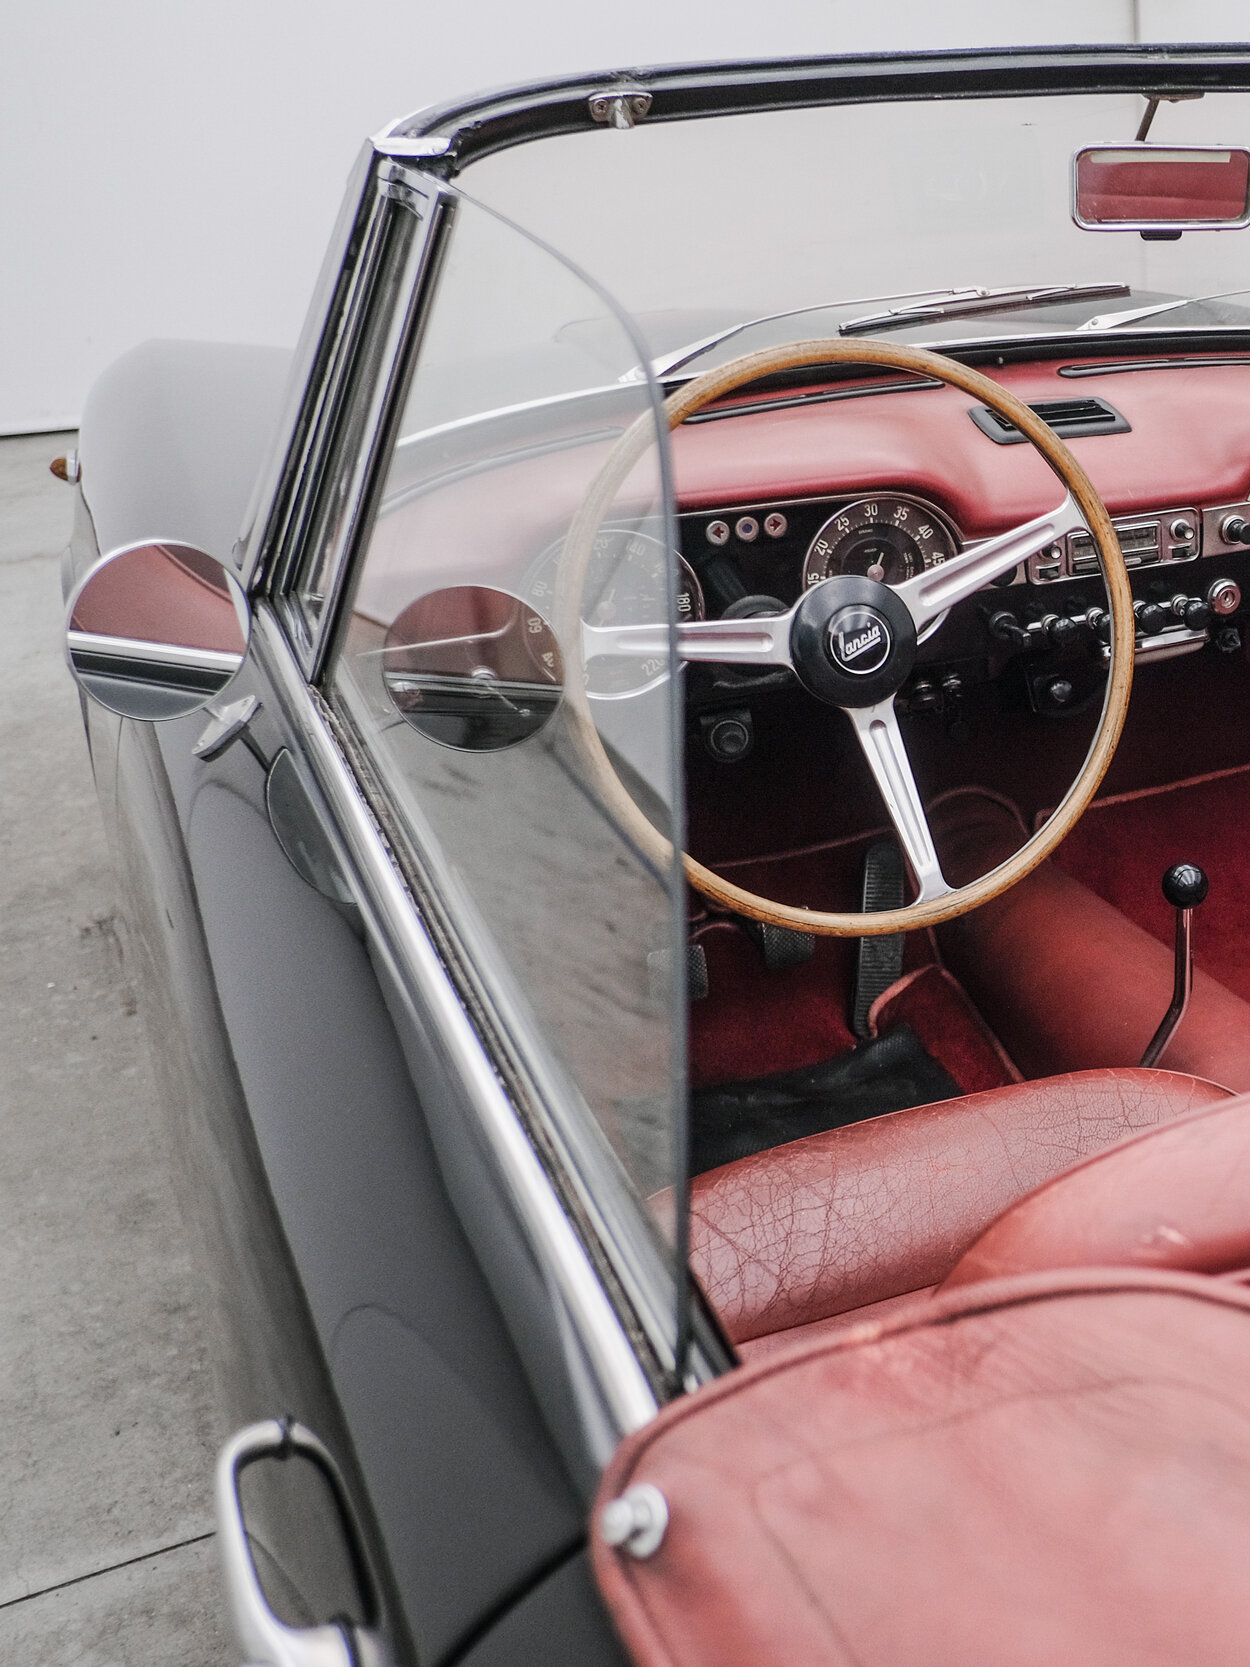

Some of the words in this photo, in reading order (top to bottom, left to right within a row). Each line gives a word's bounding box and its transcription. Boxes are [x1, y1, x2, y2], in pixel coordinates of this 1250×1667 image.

[864, 503, 878, 517] 30
[893, 506, 910, 521] 35
[834, 516, 850, 531] 25
[918, 524, 934, 540] 40
[814, 539, 829, 556] 20
[932, 551, 946, 567] 45
[807, 572, 820, 586] 15
[676, 592, 691, 612] 180
[527, 617, 543, 634] 60
[839, 621, 881, 662] Lancia
